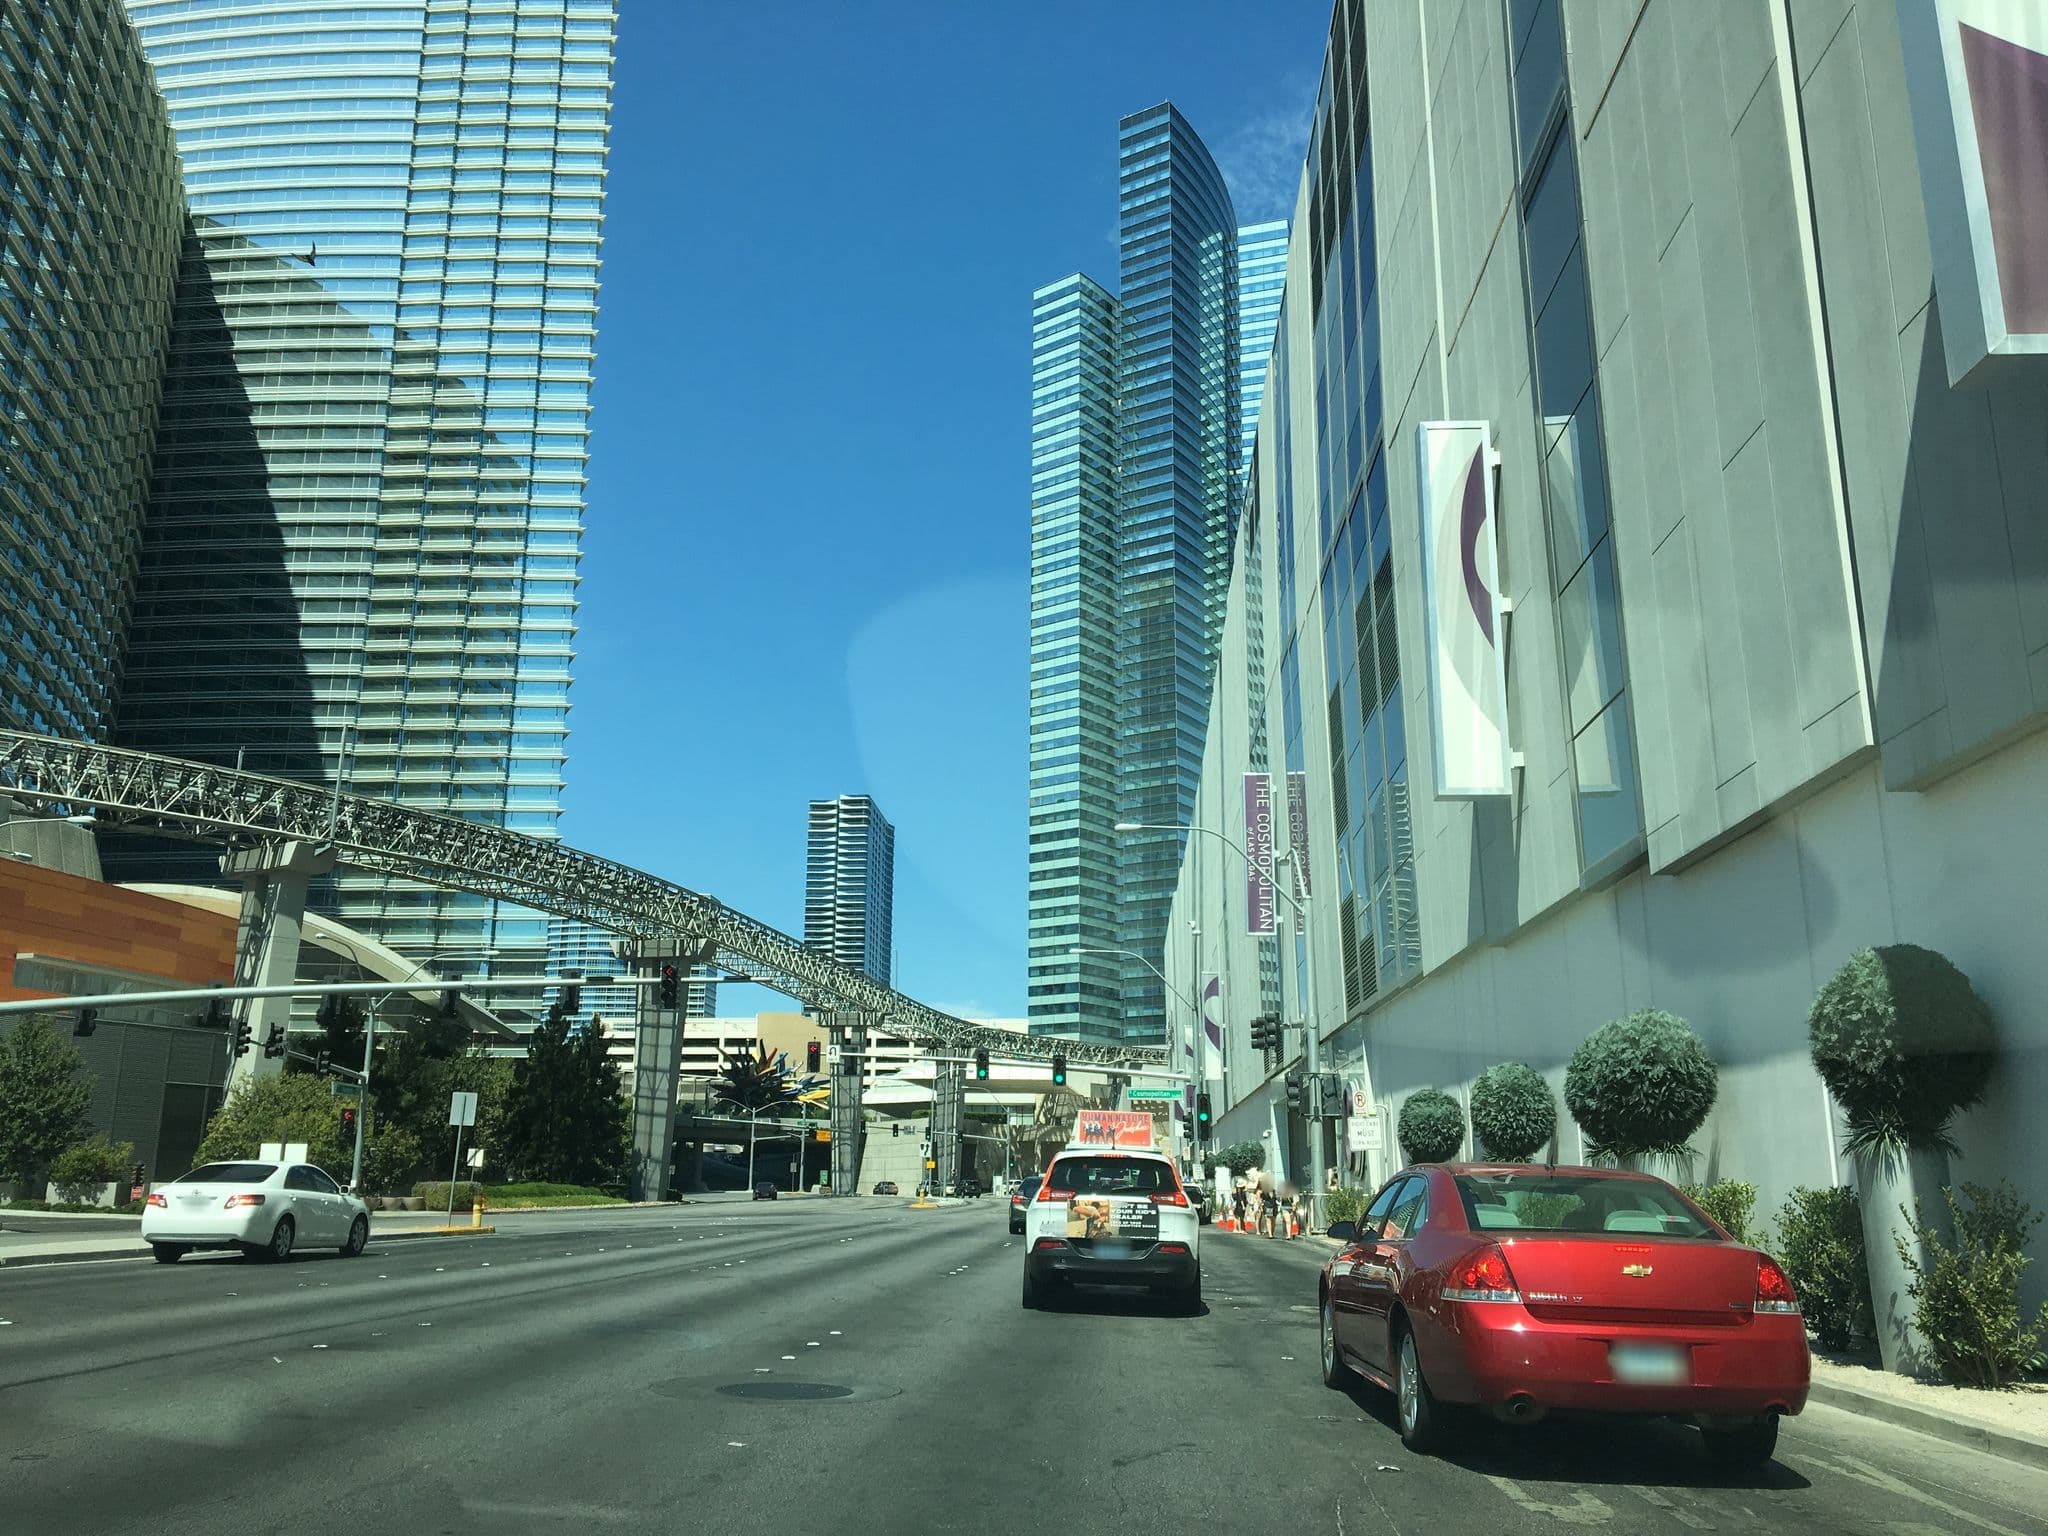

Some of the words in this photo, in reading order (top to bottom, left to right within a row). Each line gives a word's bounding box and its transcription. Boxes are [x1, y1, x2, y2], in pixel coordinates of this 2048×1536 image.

[1256, 779, 1269, 808] THE
[1247, 837, 1255, 853] LAS
[1257, 813, 1273, 930] COSMOPOLITAN
[1132, 1090, 1171, 1098] Cosmopolitan
